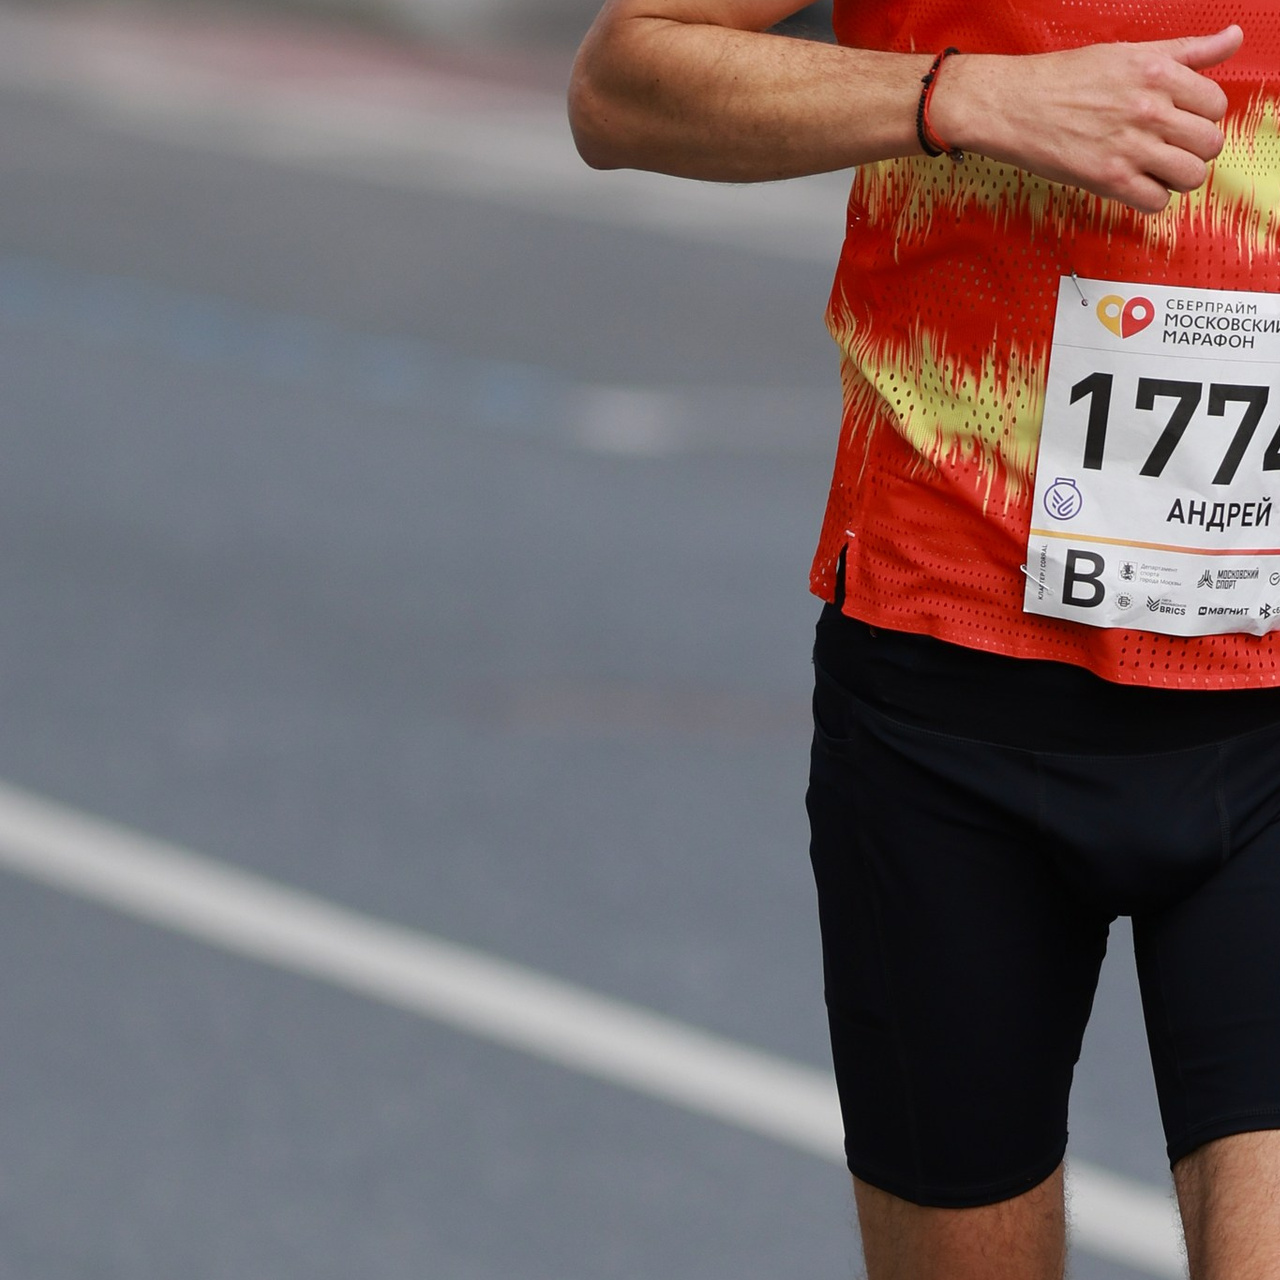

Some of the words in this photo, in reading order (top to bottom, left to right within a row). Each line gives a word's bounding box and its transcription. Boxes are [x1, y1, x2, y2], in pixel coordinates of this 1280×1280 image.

[1166, 299, 1257, 314] СБЕРПРАЙМ
[1162, 330, 1255, 349] МАРАФОН
[1166, 496, 1273, 532] АНДРЕЙ
[1040, 544, 1048, 568] CORRAL
[1217, 567, 1260, 580] МОСКОВСКИЙ
[1215, 579, 1237, 589] СПОРТ
[1159, 605, 1186, 616] BRICS
